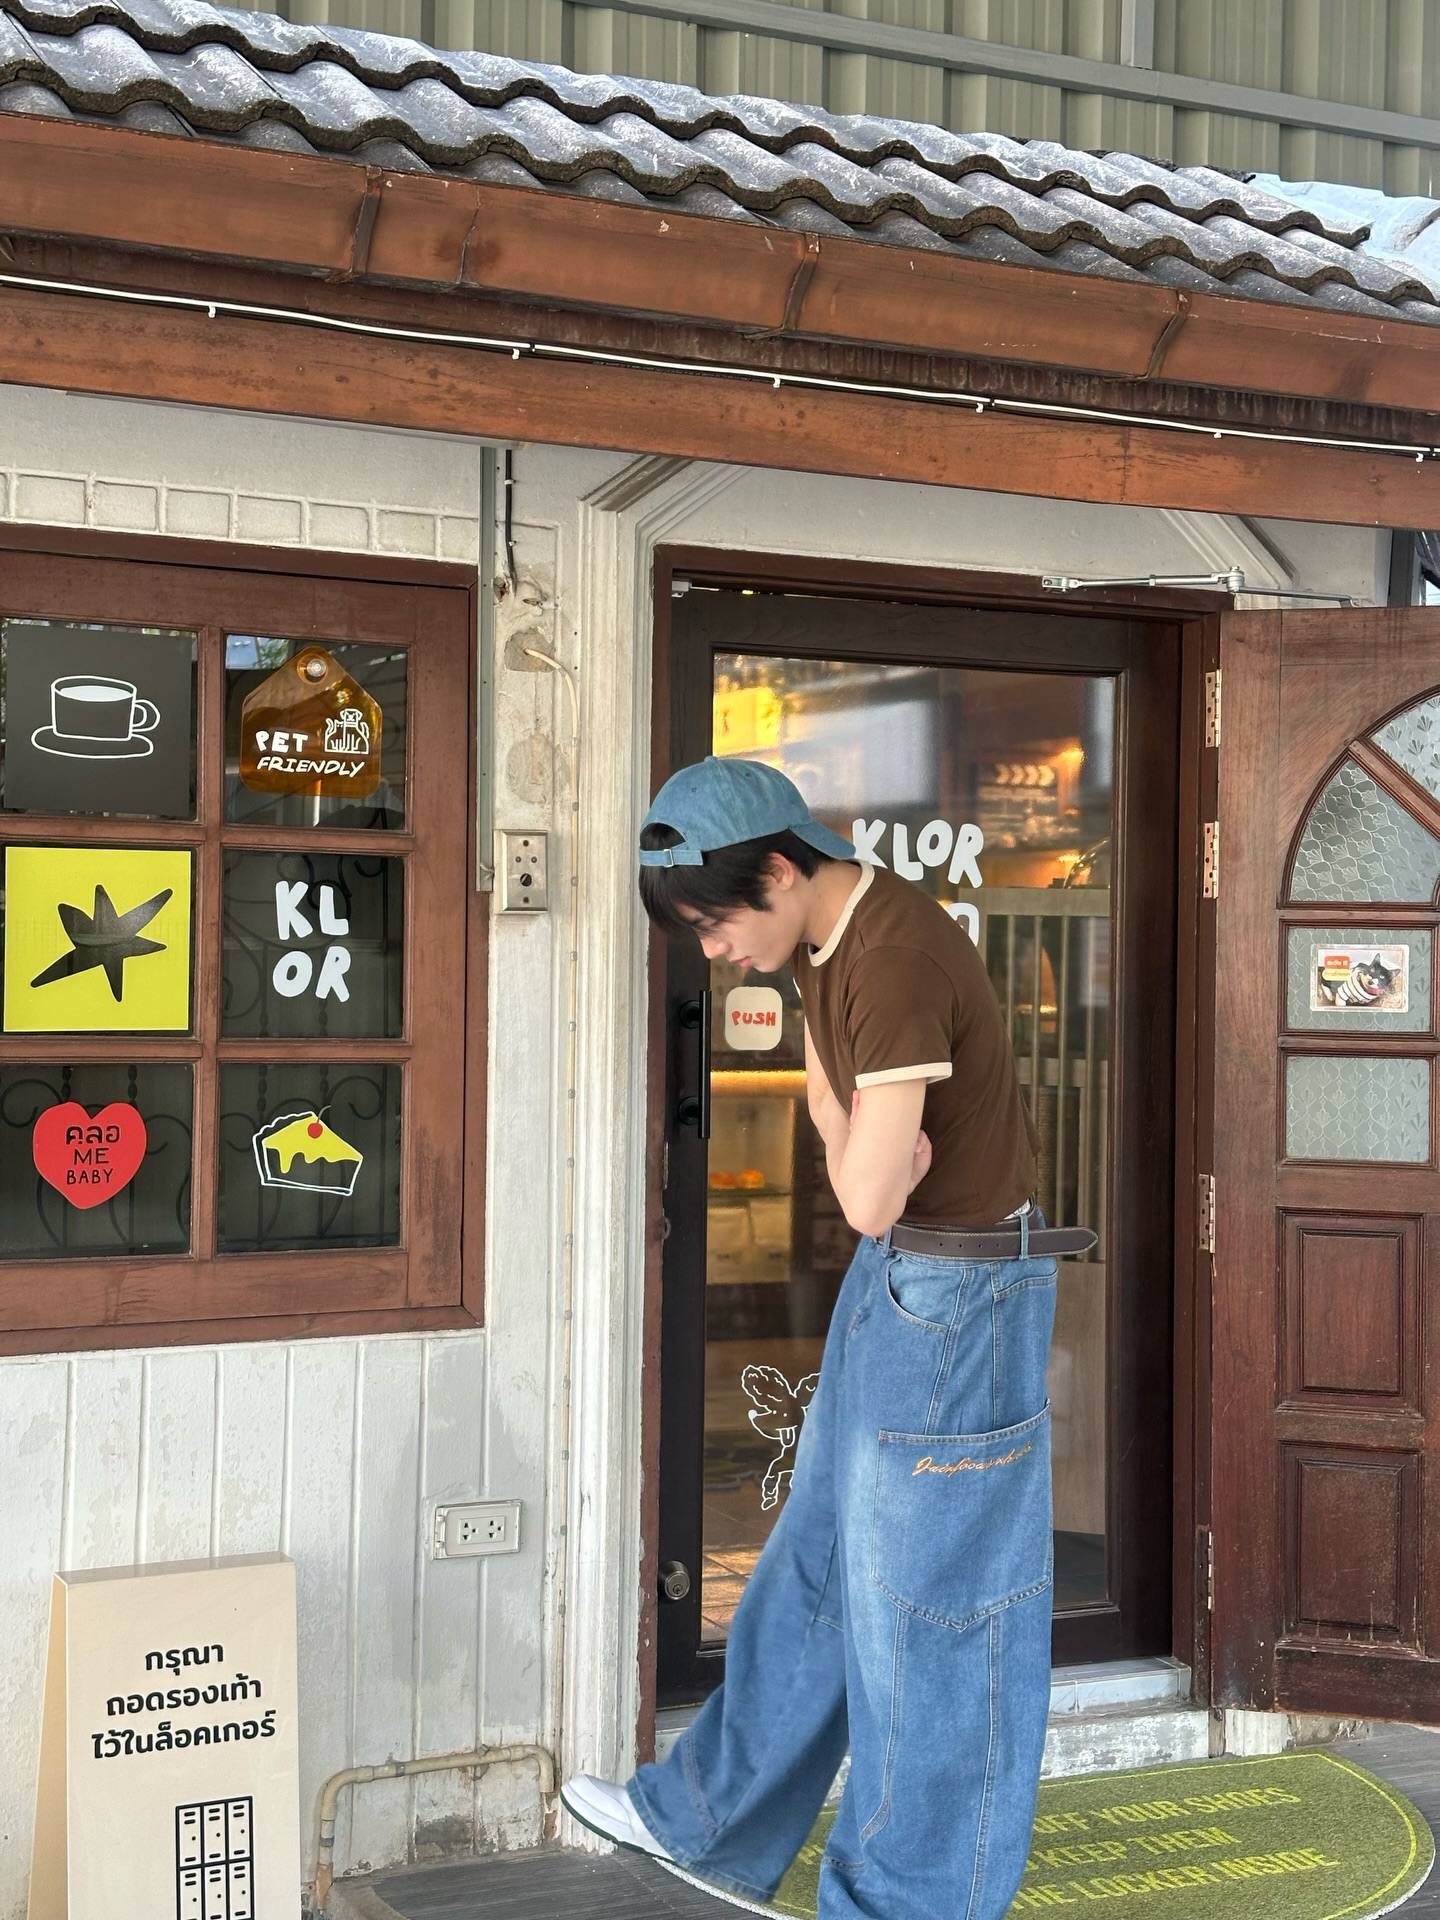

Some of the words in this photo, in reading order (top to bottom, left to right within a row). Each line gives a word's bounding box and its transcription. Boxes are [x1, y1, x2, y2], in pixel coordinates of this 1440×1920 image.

[255, 730, 309, 753] PET
[256, 756, 365, 778] FRIENDLY
[852, 818, 984, 889] KLOR
[275, 880, 349, 940] KL
[272, 945, 351, 1003] OR
[731, 1010, 776, 1027] PUSH
[66, 1167, 114, 1185] BABY
[73, 1147, 109, 1165] ME
[145, 1643, 224, 1677] กรุณา
[106, 1672, 262, 1717] ถอดรองเท้า
[91, 1709, 277, 1759] ไว้ในล็อคเกอร์
[1089, 1799, 1191, 1827] YOUR
[1183, 1786, 1302, 1814] SHOES
[1032, 1839, 1129, 1868] KEEP
[1126, 1826, 1243, 1856] THEM
[1067, 1864, 1222, 1900] LOCKER
[1209, 1847, 1342, 1880] INSIDE
